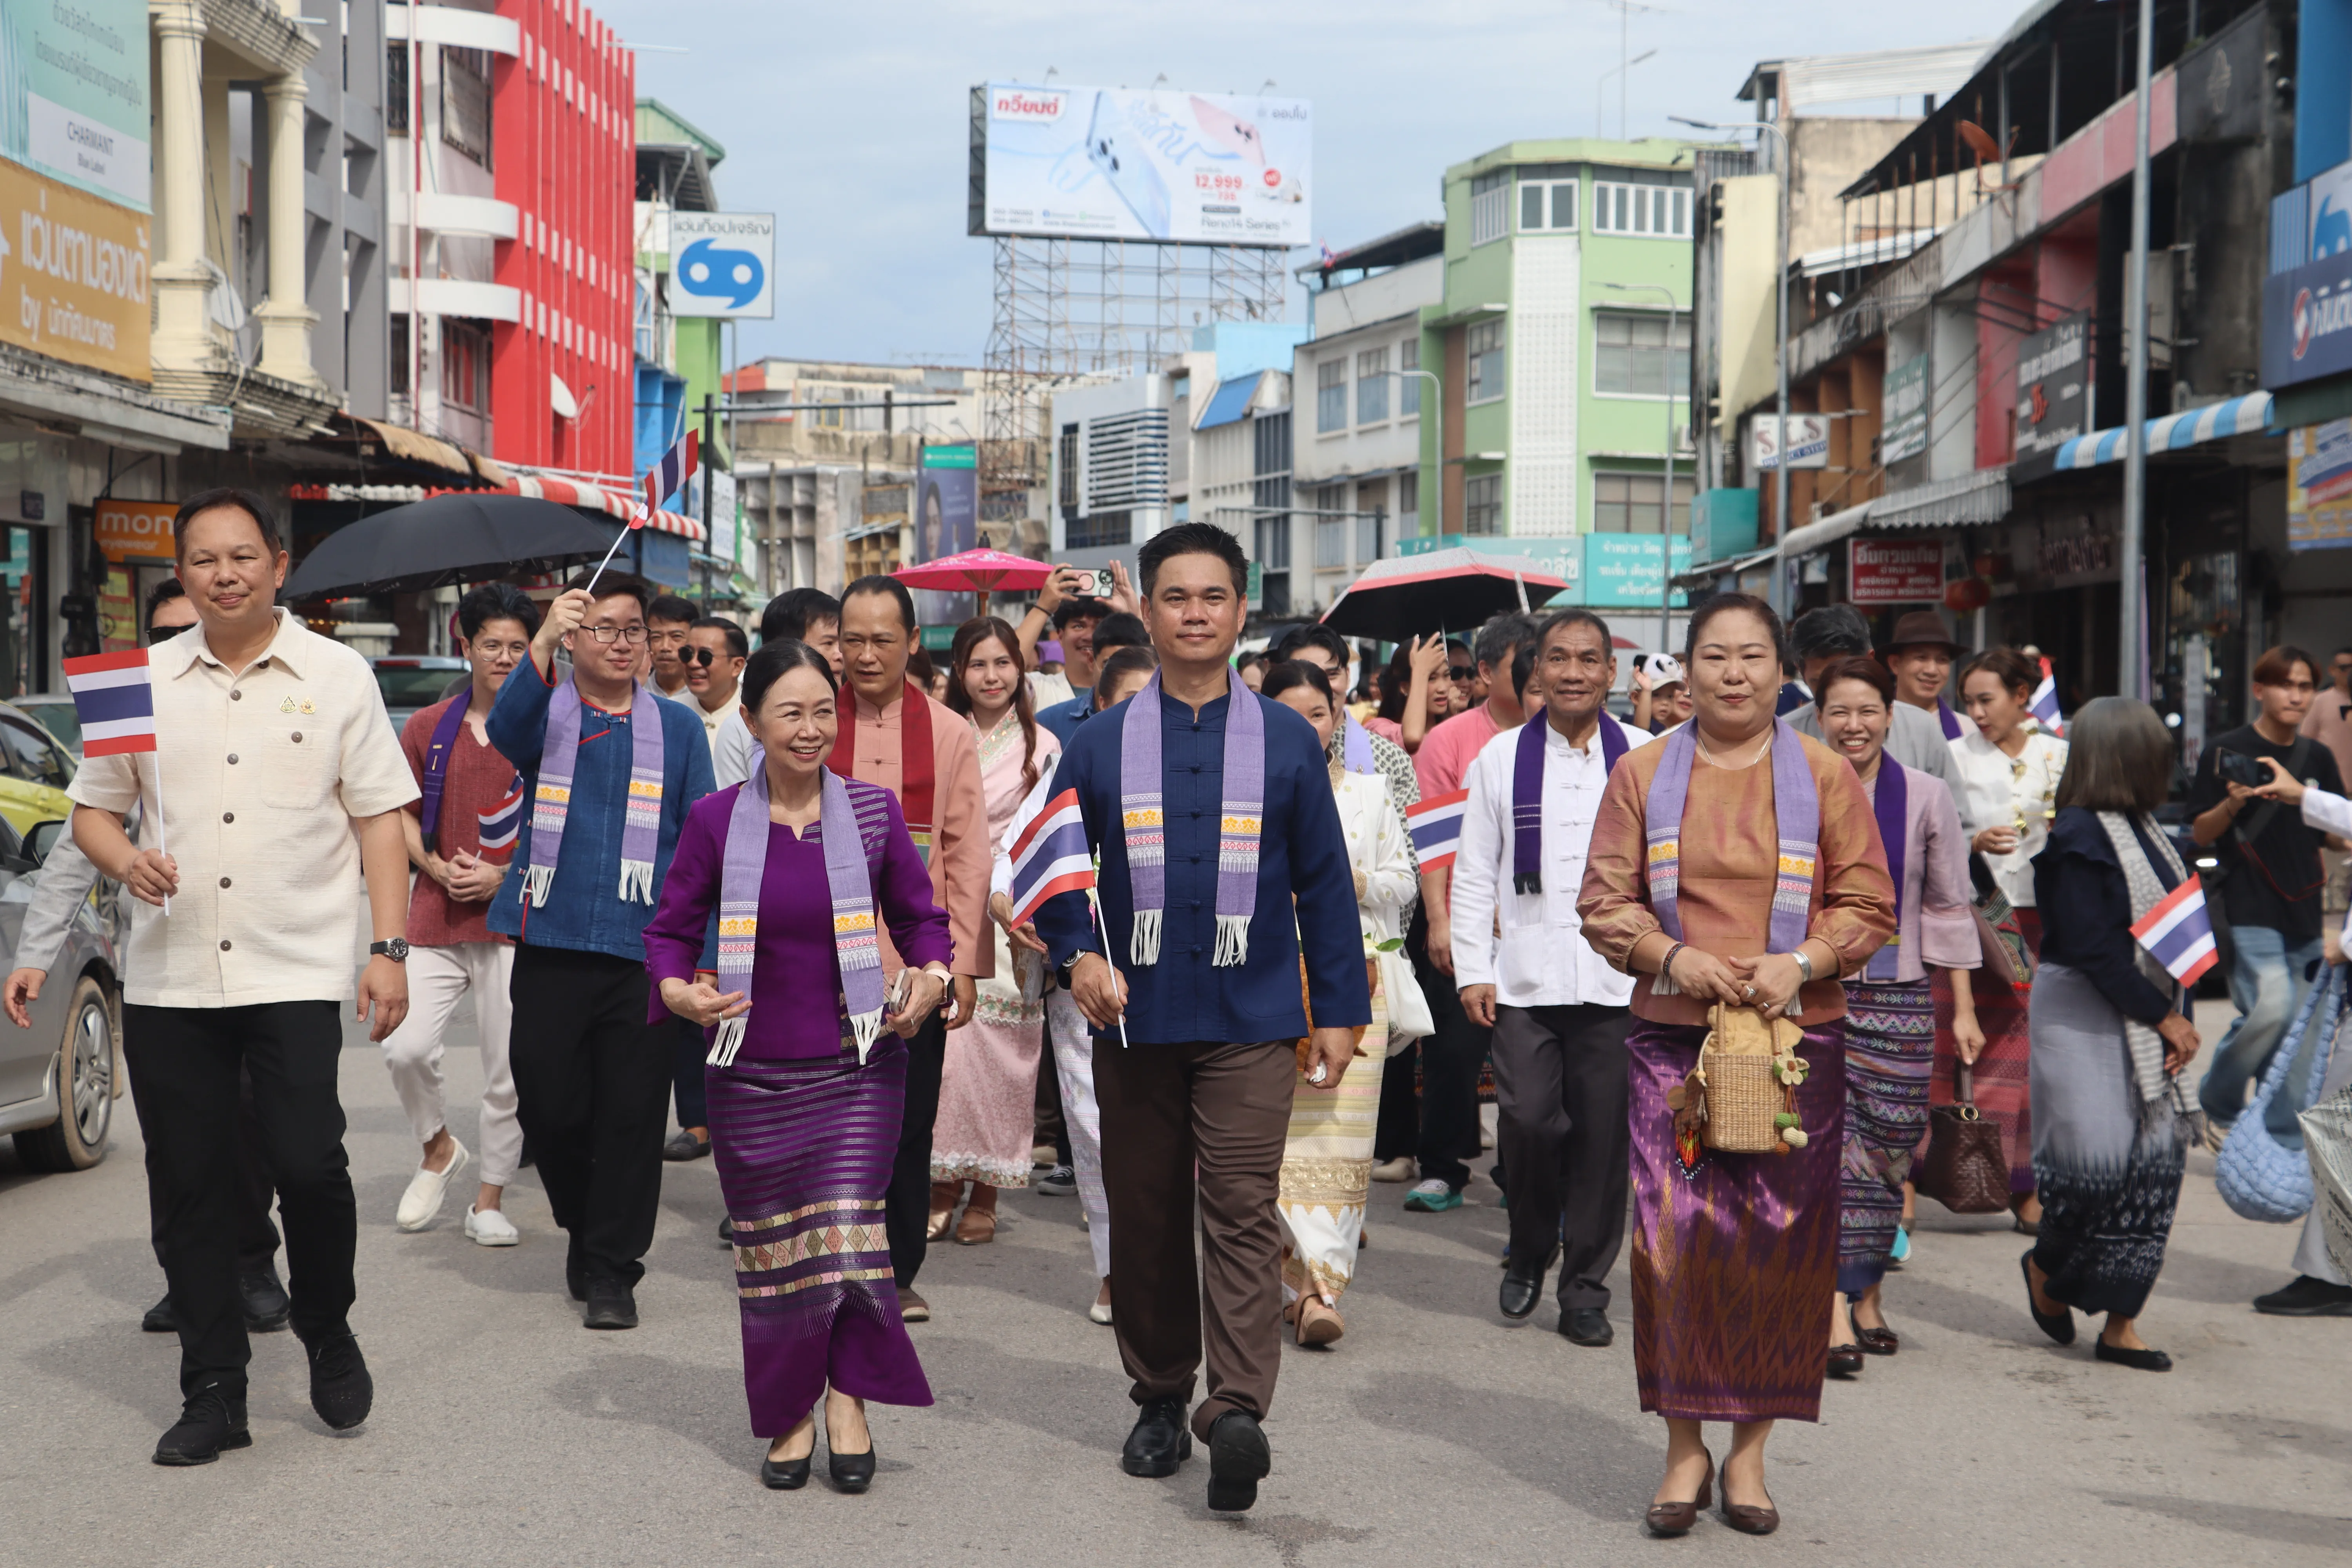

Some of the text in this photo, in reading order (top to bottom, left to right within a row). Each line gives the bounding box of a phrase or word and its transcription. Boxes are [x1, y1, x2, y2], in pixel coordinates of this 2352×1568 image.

[68, 120, 114, 156] CHARMANT
[1245, 217, 1280, 231] Series
[22, 189, 149, 305] แว่นตามองดี
[21, 283, 41, 343] by
[101, 511, 175, 537] mon
[99, 538, 159, 551] eyewear
